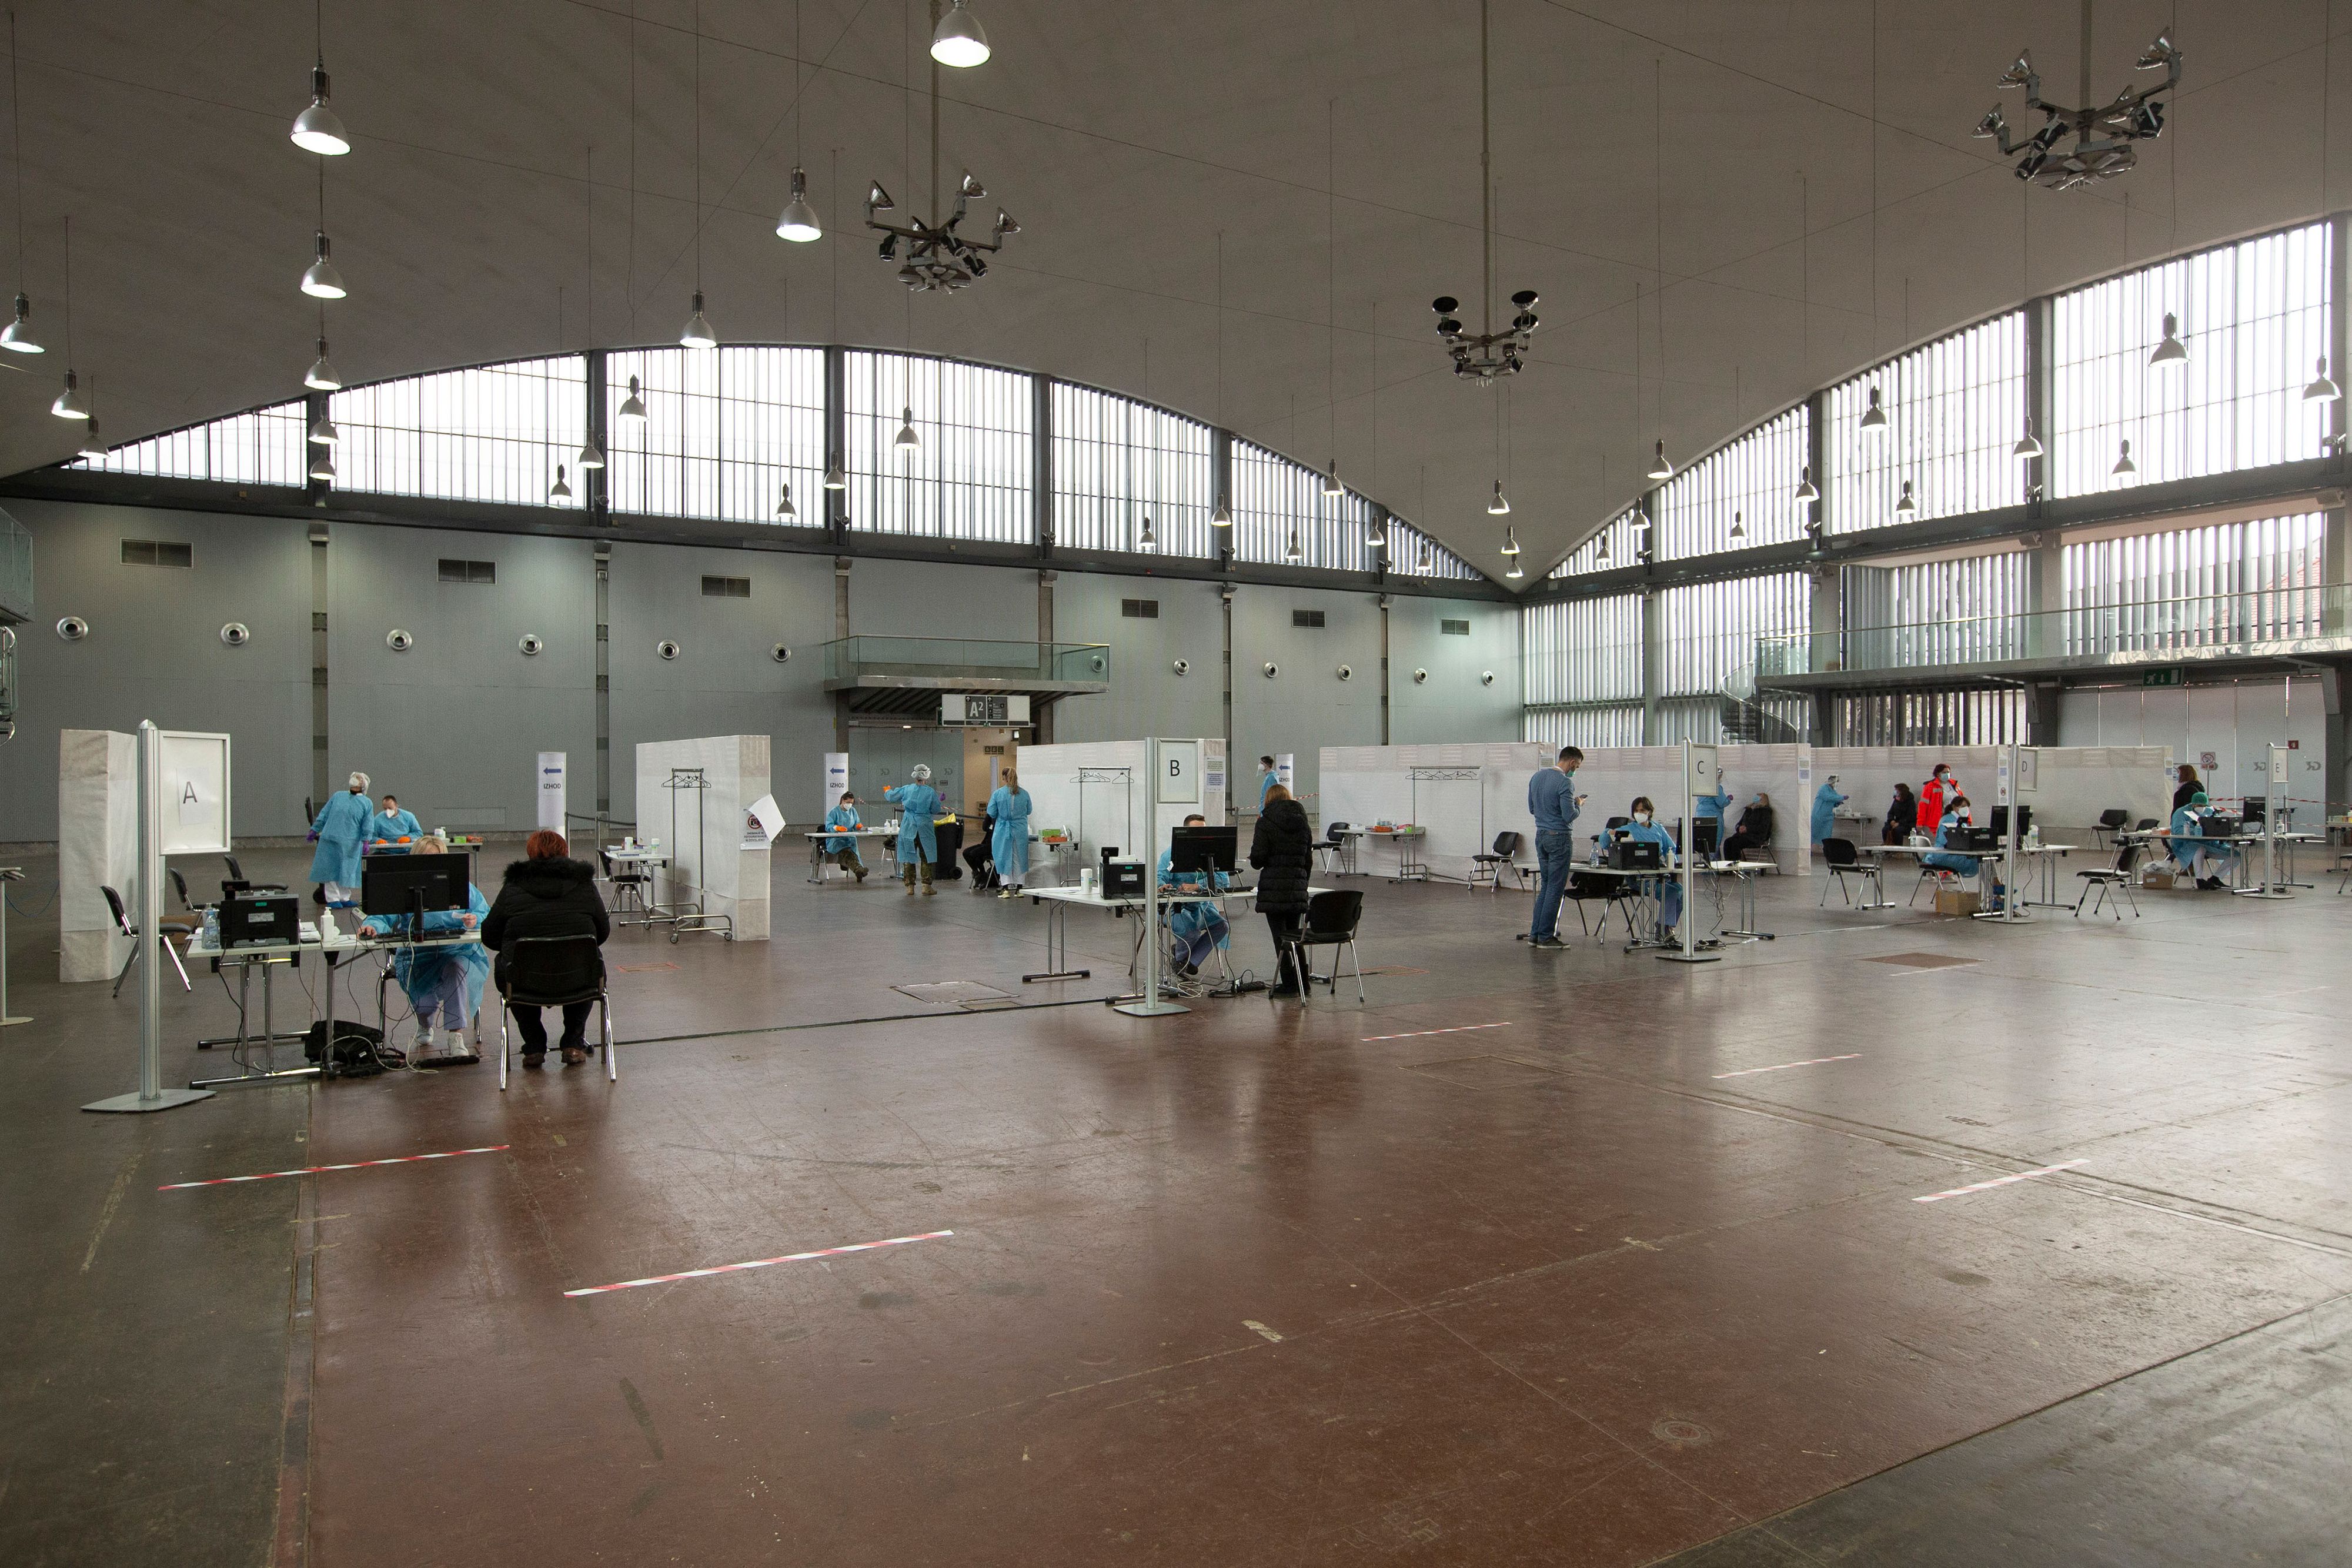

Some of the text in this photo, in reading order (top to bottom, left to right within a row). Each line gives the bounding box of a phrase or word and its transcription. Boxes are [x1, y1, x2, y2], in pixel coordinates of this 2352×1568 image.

[1170, 760, 1180, 776] B
[1698, 761, 1704, 774] C
[2022, 761, 2027, 772] D
[2276, 763, 2280, 773] E
[183, 781, 198, 804] A
